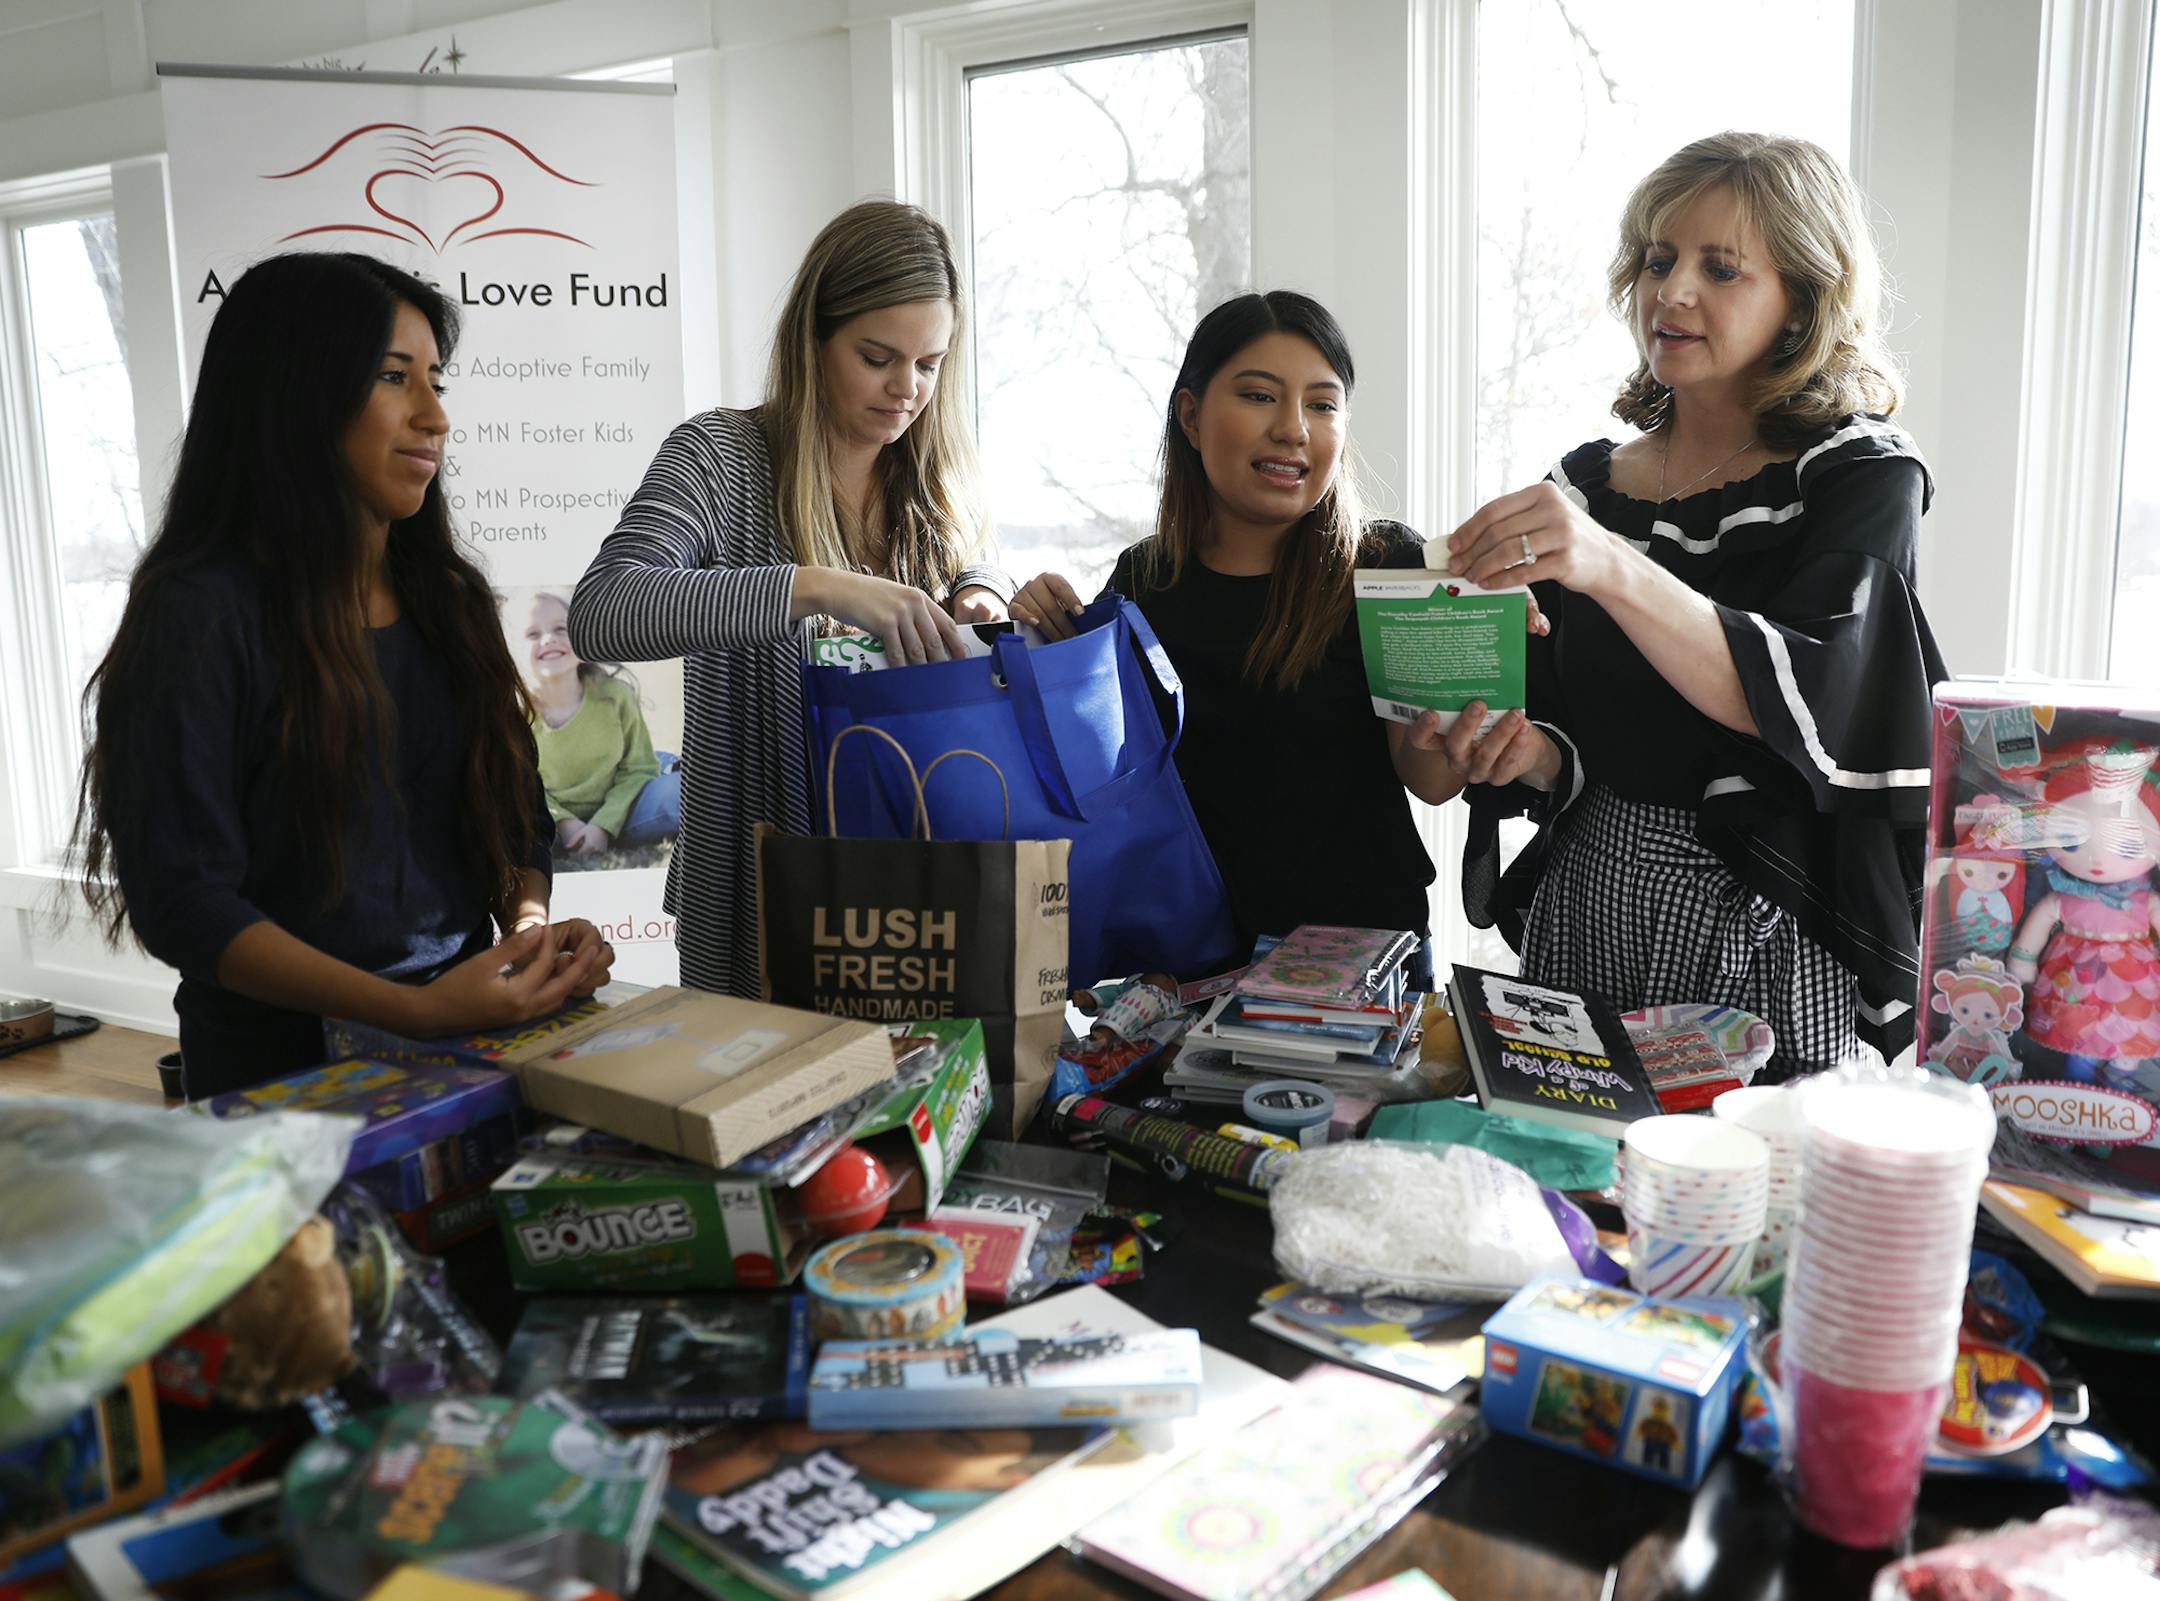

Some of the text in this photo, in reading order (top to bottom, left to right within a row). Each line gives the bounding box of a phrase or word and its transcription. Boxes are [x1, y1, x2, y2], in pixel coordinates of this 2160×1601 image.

[460, 272, 552, 306] Love
[570, 273, 667, 307] Fund
[470, 356, 572, 382] Adoptive
[582, 356, 650, 382] Family
[478, 422, 510, 443] MN
[521, 422, 585, 443] Foster
[594, 421, 634, 443] Kids
[445, 456, 462, 477] &
[476, 488, 508, 509] MN
[519, 487, 632, 513] Prospectiv
[470, 521, 547, 542] Parents
[813, 908, 957, 951] LUSH
[813, 955, 957, 993] FRESH
[814, 995, 955, 1021] HANDMADE
[1503, 1040, 1612, 1069] OLD SCHOOL
[1502, 1052, 1633, 1092] Wimpy Kid
[1535, 1084, 1617, 1111] DIARY
[971, 1194, 1053, 1222] BAG
[519, 1199, 695, 1265] BOUNCE
[697, 1451, 859, 1535] Daddy
